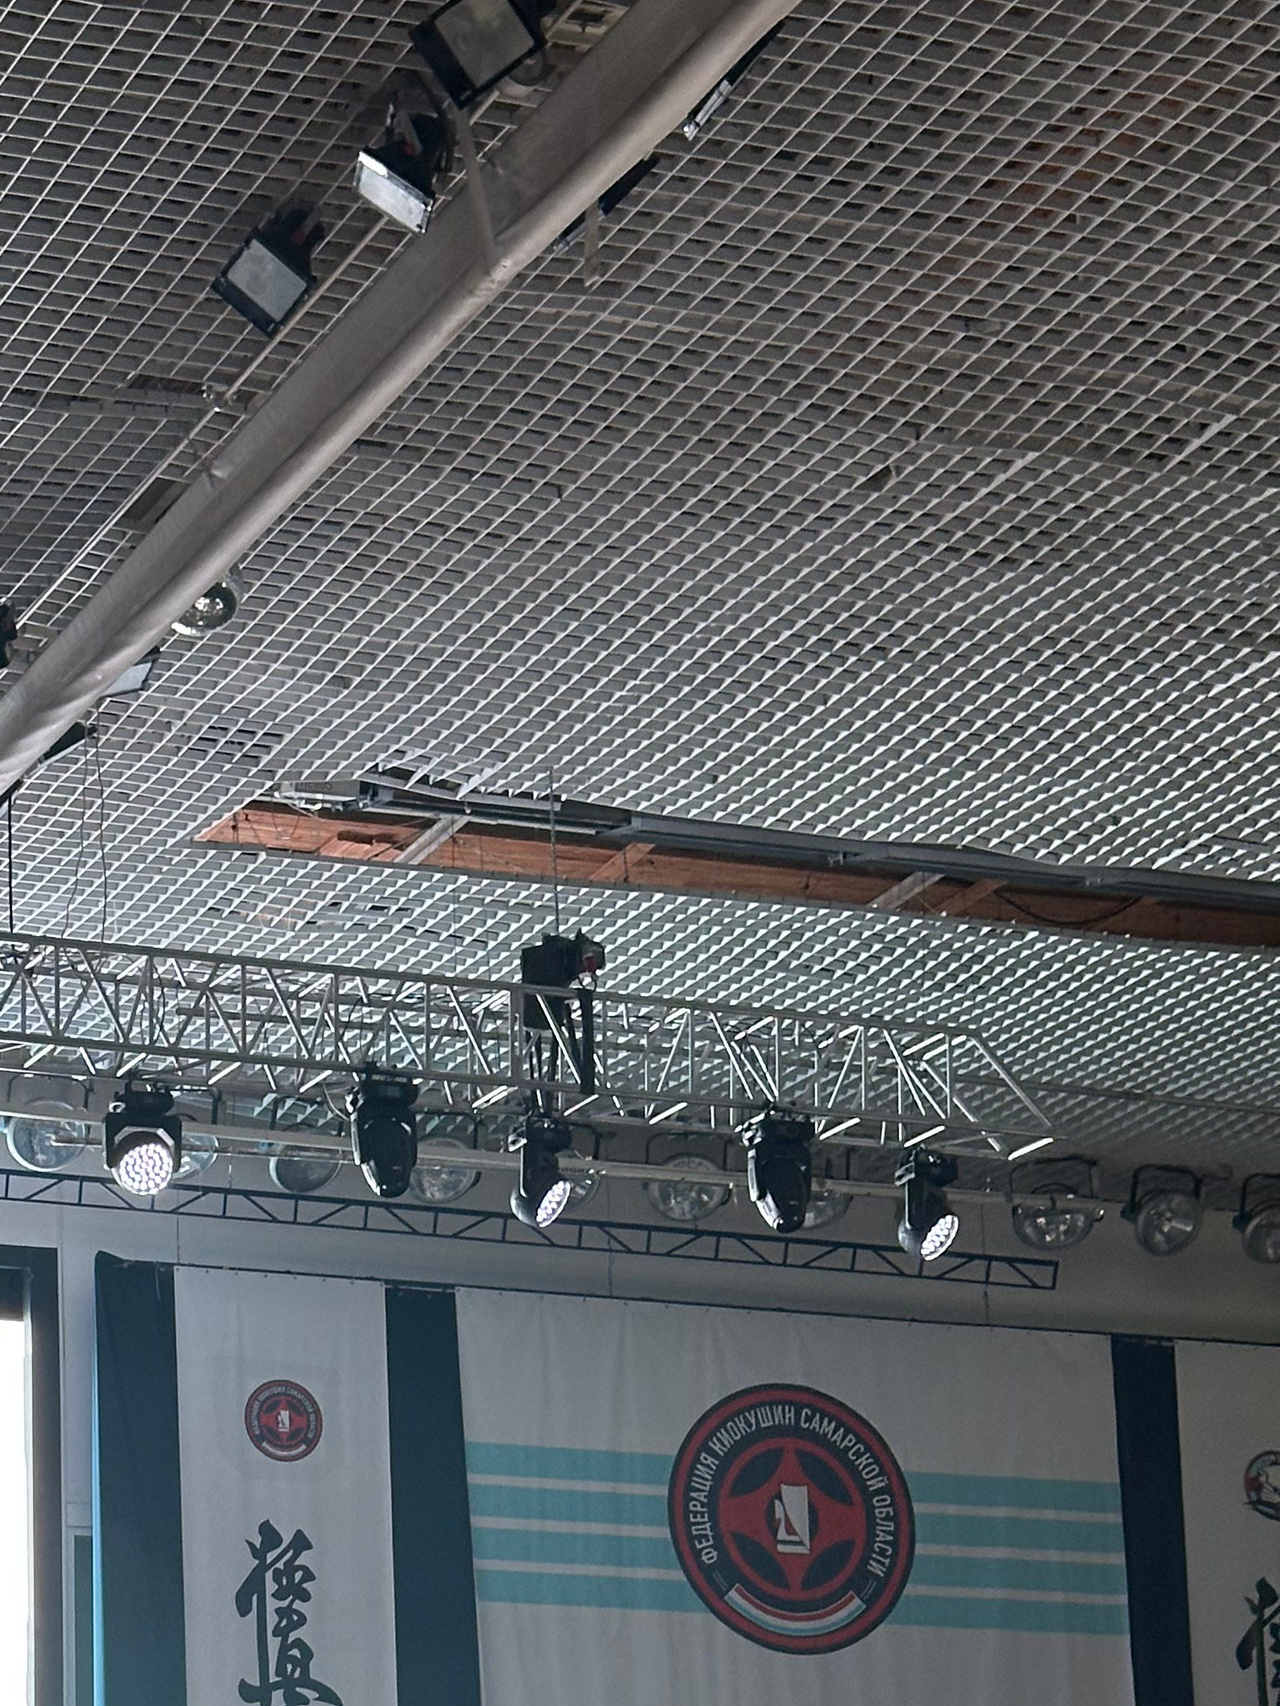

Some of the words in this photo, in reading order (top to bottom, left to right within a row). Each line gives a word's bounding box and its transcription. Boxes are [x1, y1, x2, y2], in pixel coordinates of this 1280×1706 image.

[688, 1452, 719, 1565] ФЕДЕРАЦИЯ
[708, 1404, 795, 1457] КИОКУШИН
[800, 1407, 889, 1495] САМАРСКОЙ
[867, 1494, 895, 1578] ОБЛАСТИ
